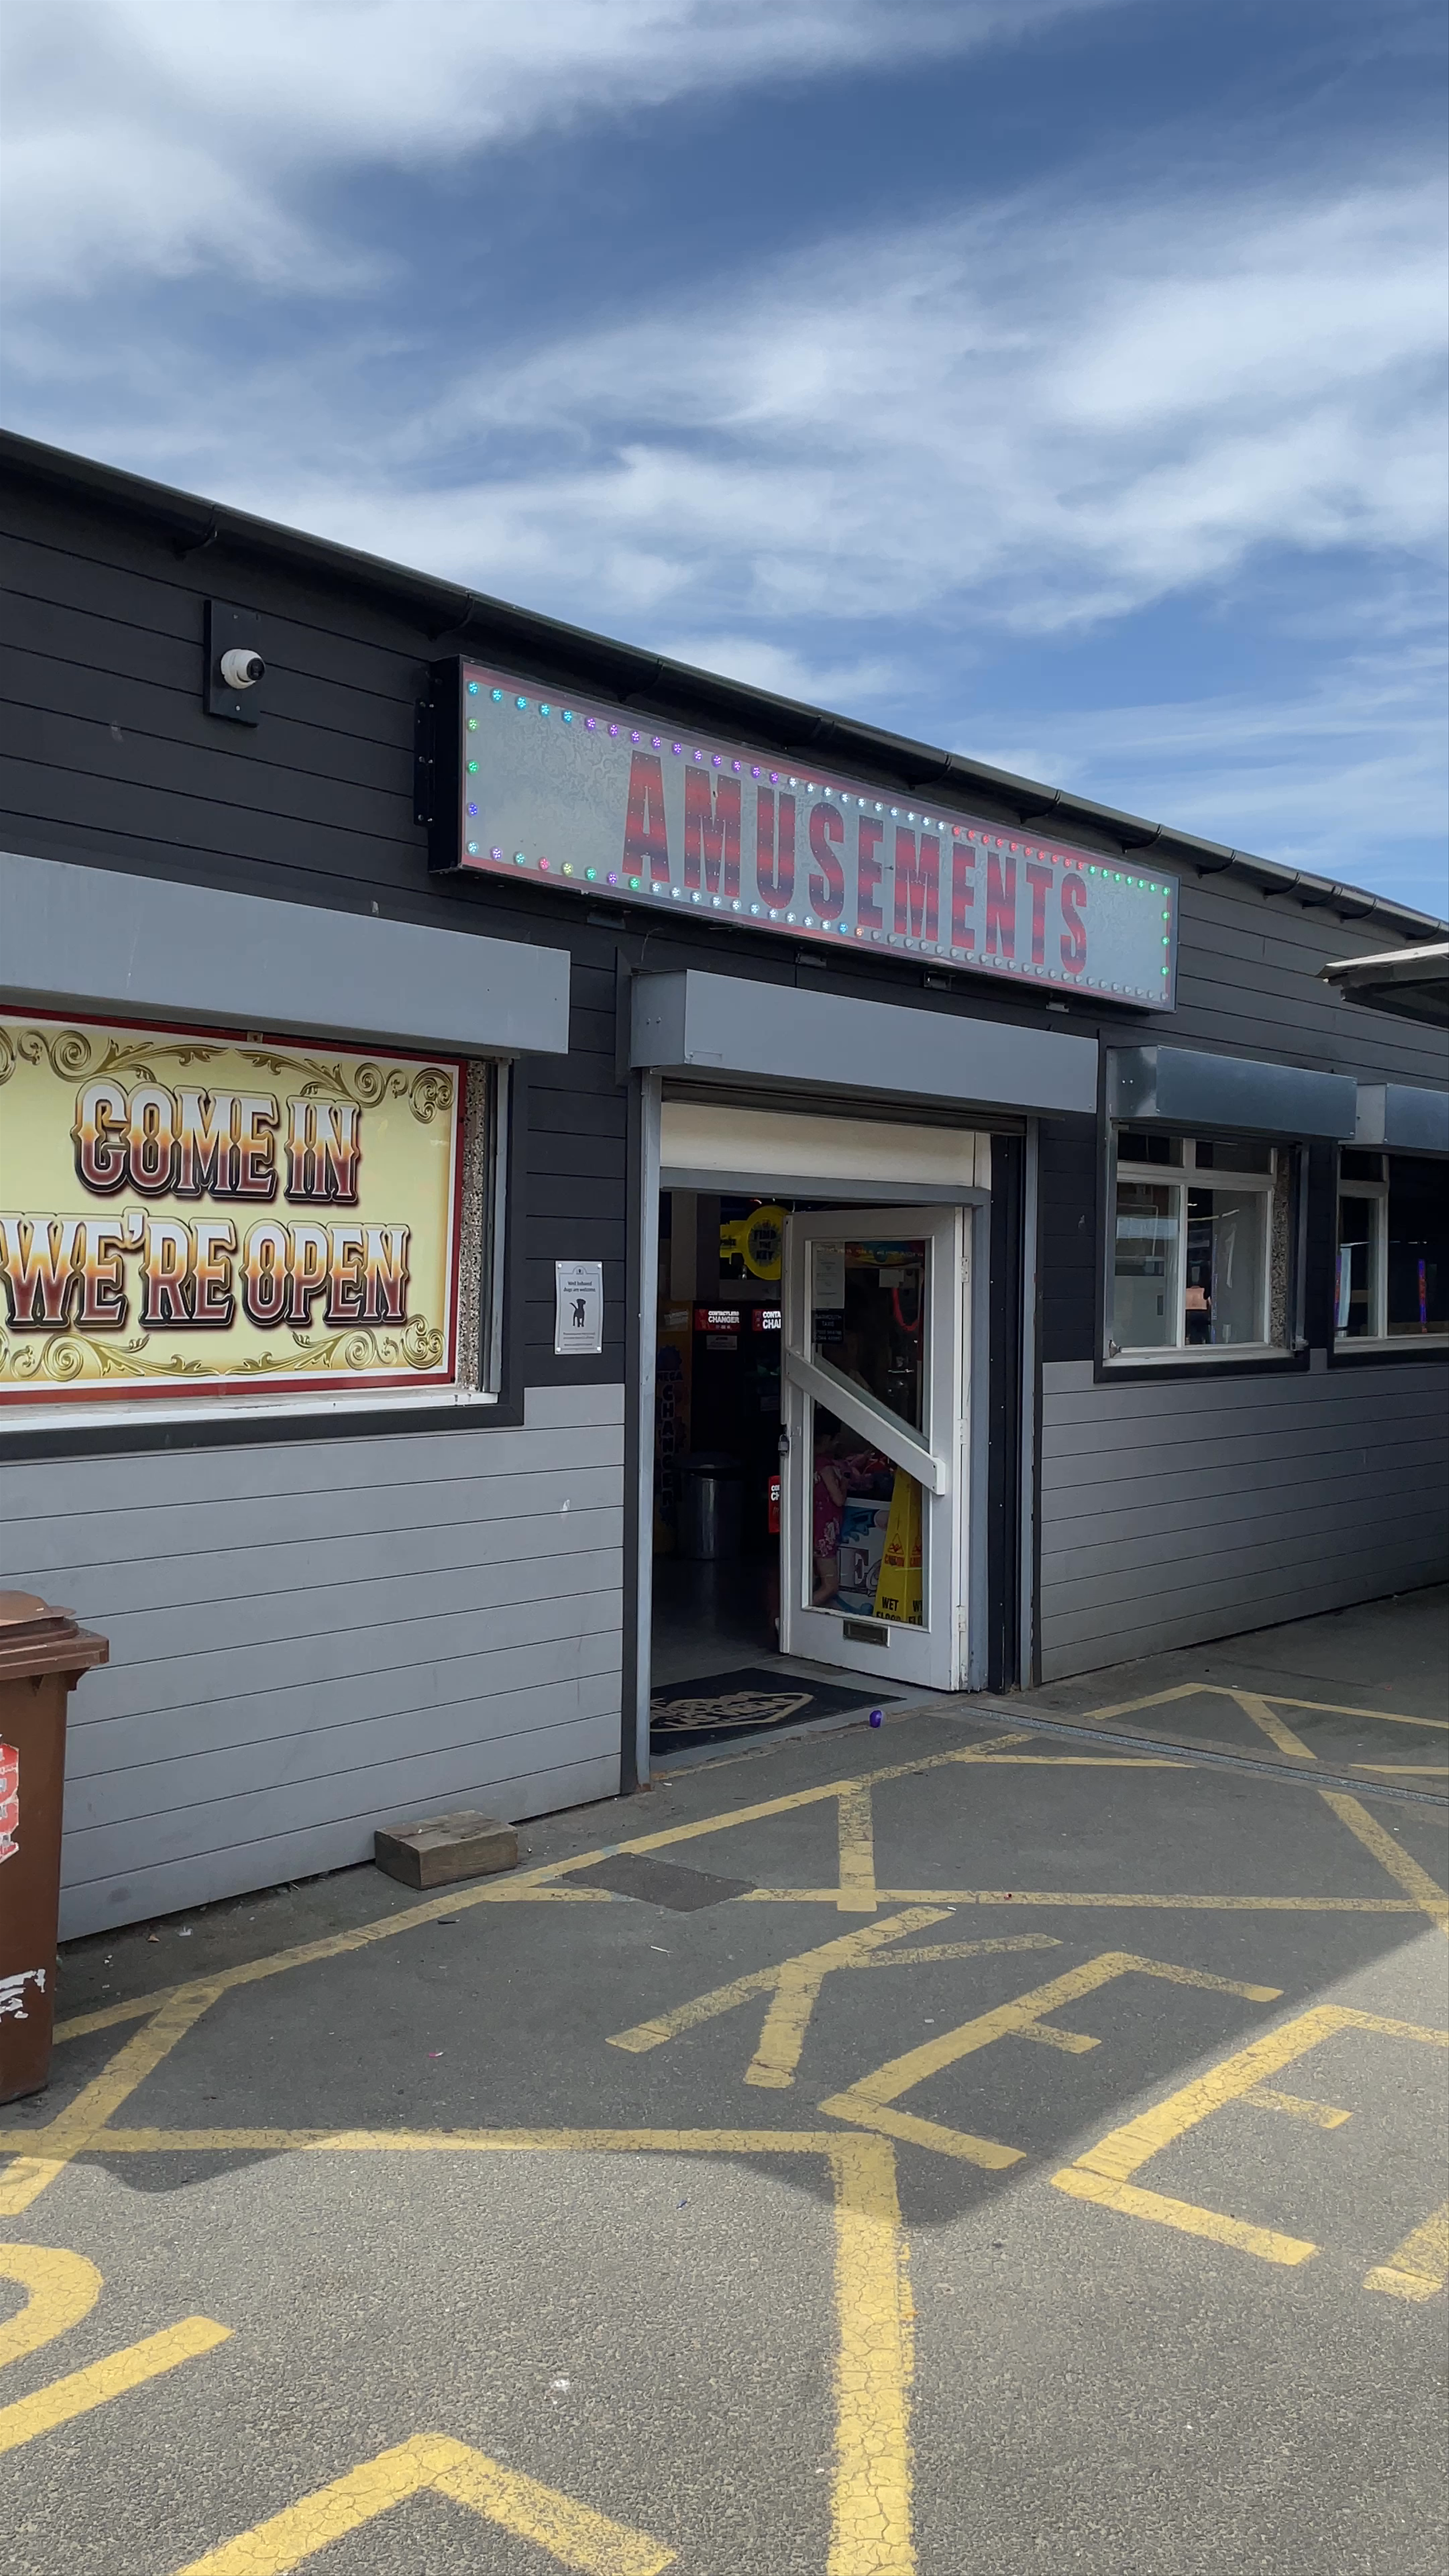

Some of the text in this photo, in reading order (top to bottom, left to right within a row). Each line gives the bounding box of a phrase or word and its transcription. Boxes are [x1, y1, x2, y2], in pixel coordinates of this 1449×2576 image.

[622, 749, 1087, 974] AMUSEMENTS
[71, 1077, 360, 1203] COME IN
[0, 1206, 411, 1329] WE'RE OPEN
[882, 1596, 899, 1611] WET
[607, 1905, 1449, 2302] KEE
